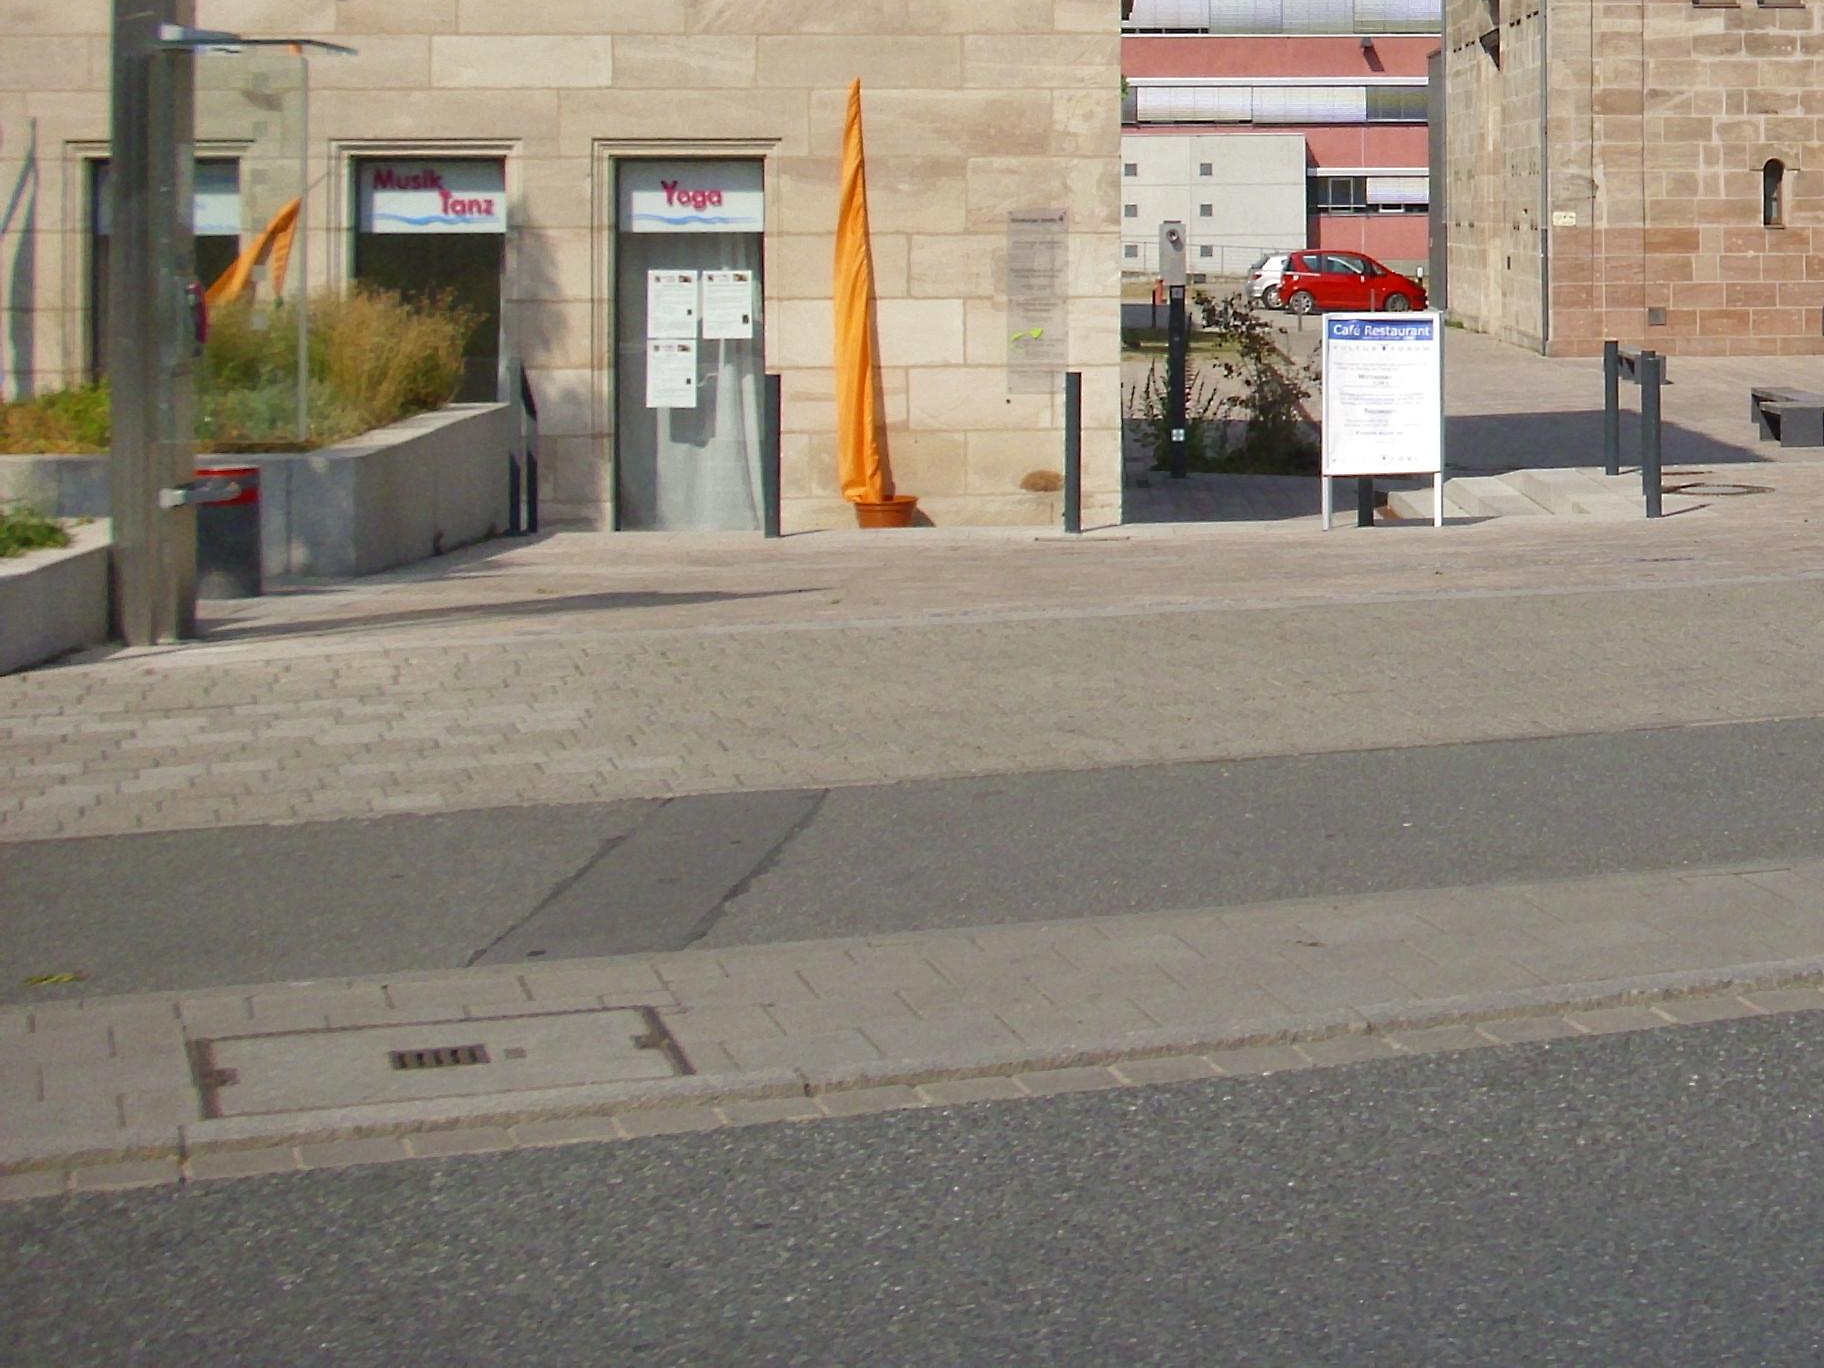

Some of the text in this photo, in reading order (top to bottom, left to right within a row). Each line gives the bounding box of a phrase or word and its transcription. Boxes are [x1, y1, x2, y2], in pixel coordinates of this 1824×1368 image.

[373, 168, 443, 190] Musik
[438, 188, 495, 215] Tanz
[660, 179, 723, 212] Yoga
[1333, 323, 1430, 337] Café Restaurant
